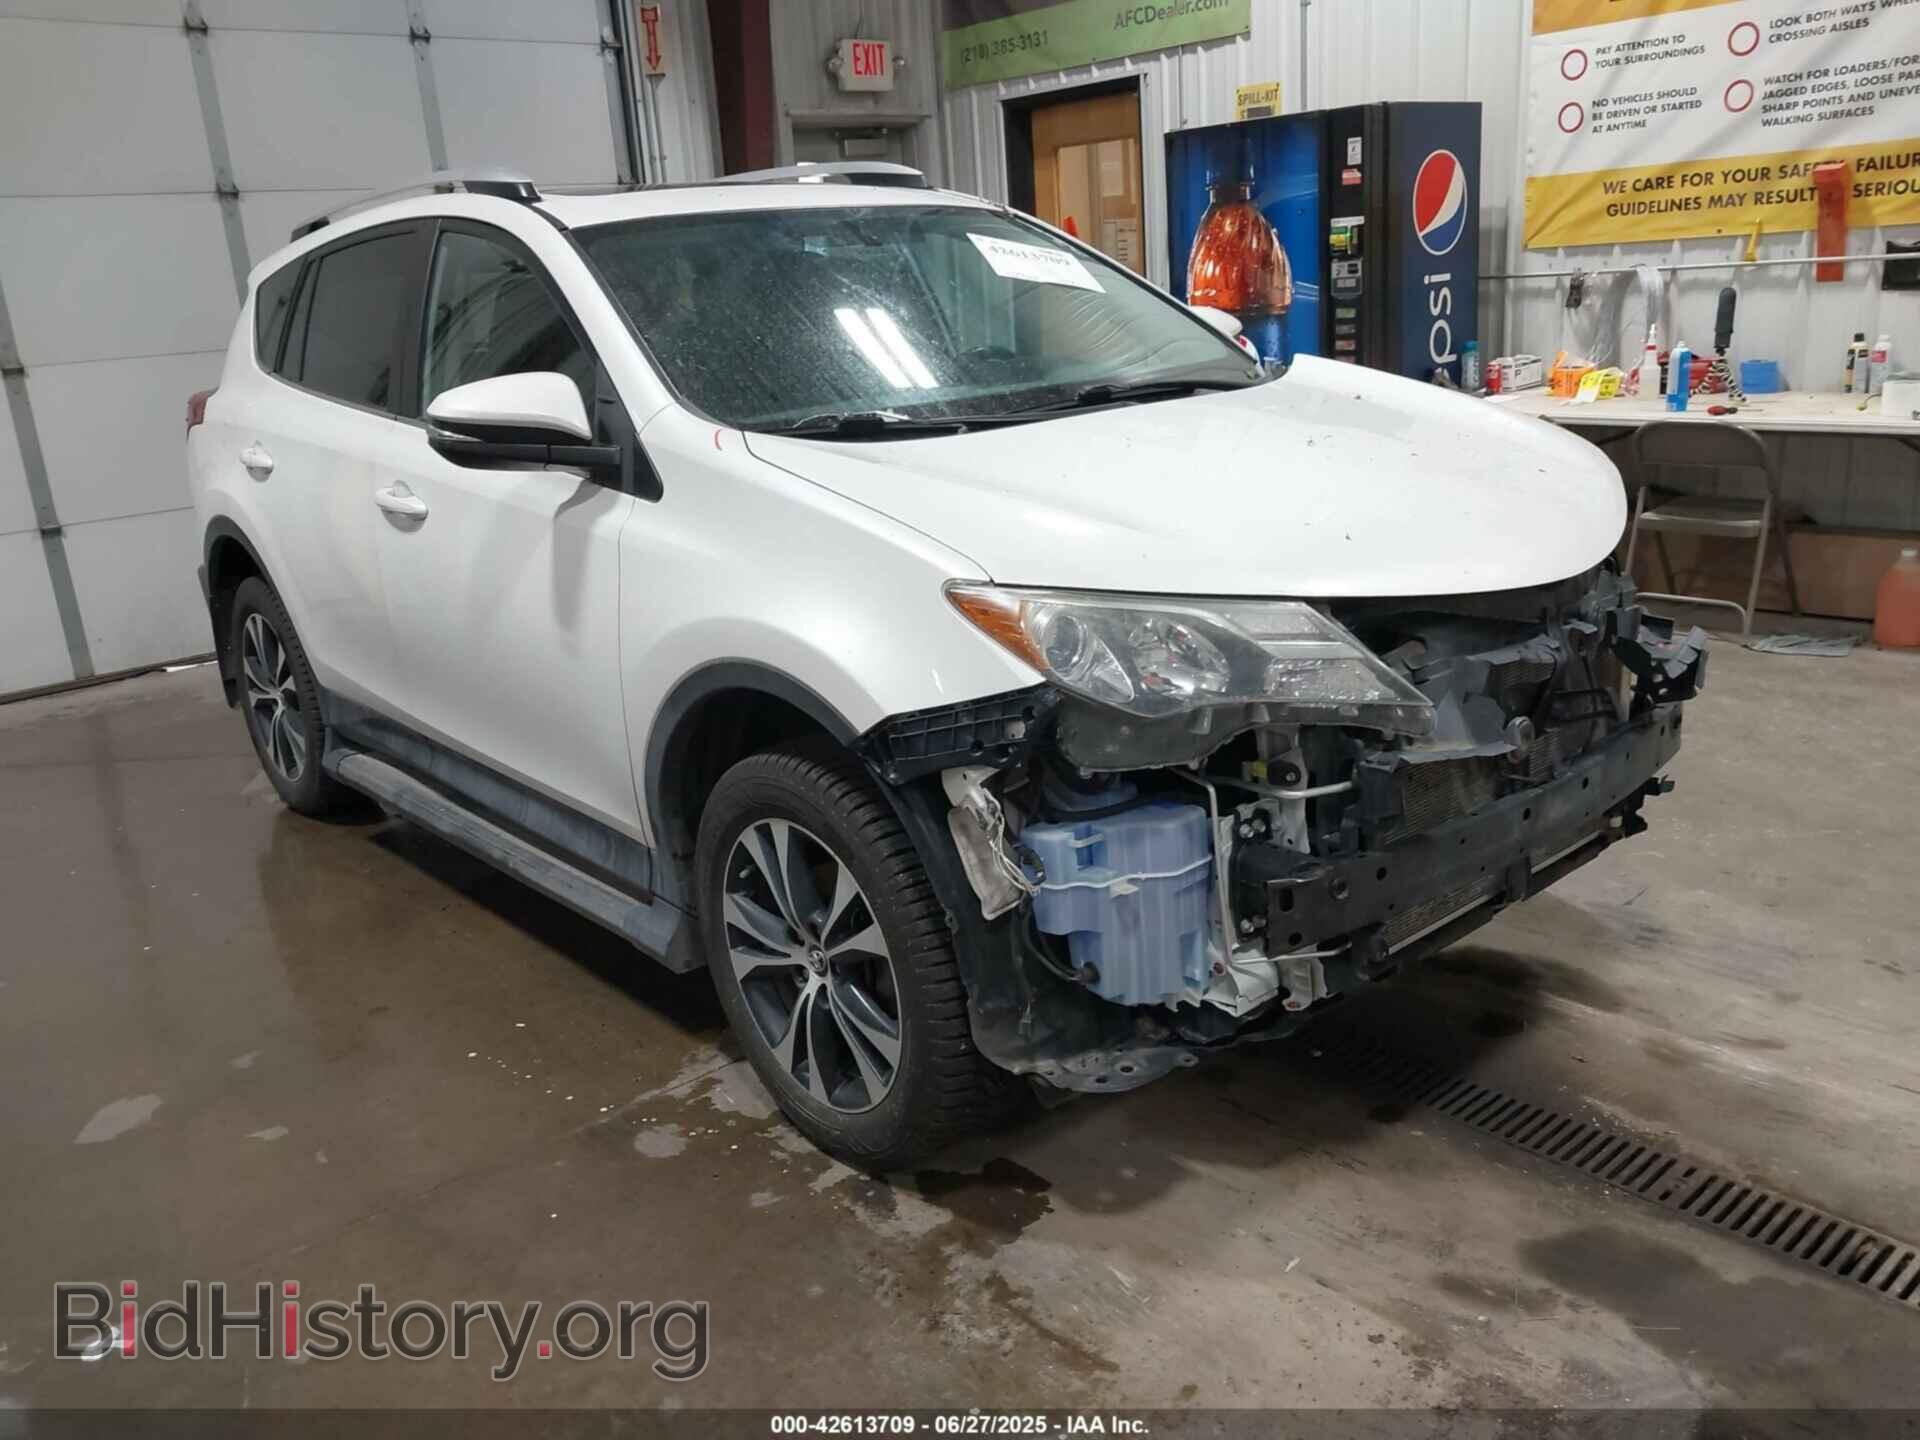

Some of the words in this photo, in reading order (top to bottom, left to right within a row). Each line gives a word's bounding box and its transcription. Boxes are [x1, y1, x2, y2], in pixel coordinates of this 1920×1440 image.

[1113, 0, 1229, 30] AFCDealer.com
[1769, 16, 1802, 29] LOOK
[1806, 9, 1837, 23] BOTH
[1841, 1, 1876, 16] WAYS
[1768, 26, 1827, 44] CROSSING
[1829, 17, 1870, 33] AISLES
[1596, 47, 1613, 55] PAY
[1615, 37, 1670, 53] ATTENTION
[1672, 34, 1686, 44] TO
[853, 43, 886, 76] EXIT
[1595, 58, 1622, 69] YOUR
[1624, 45, 1706, 65] SURROUNDINGS
[1762, 86, 1808, 100] JAGGED
[1854, 73, 1894, 88] LOOSE
[1763, 72, 1803, 86] WATCH
[1806, 68, 1831, 80] FOR
[1592, 98, 1609, 109] NO
[1612, 92, 1655, 105] VEHICLES
[1656, 87, 1698, 100] SHOULD
[1592, 112, 1603, 121] BE
[1606, 107, 1641, 119] DRIVEN
[1643, 104, 1658, 114] OR
[1661, 99, 1703, 112] STARTED
[1761, 101, 1800, 114] SHARP
[1802, 95, 1843, 109] POINTS
[1847, 90, 1875, 103] AND
[1592, 125, 1603, 134] AT
[1606, 119, 1648, 132] ANYTIME
[1761, 113, 1814, 127] WALKING
[1817, 105, 1875, 121] SURFACES
[1602, 180, 1628, 195] WE
[1632, 175, 1676, 192] CARE
[1681, 172, 1715, 188] FOR
[1721, 167, 1771, 185] YOUR
[1606, 197, 1702, 217] GUIDELINES
[1707, 192, 1748, 209] MAY
[1754, 186, 1817, 206] RESULT
